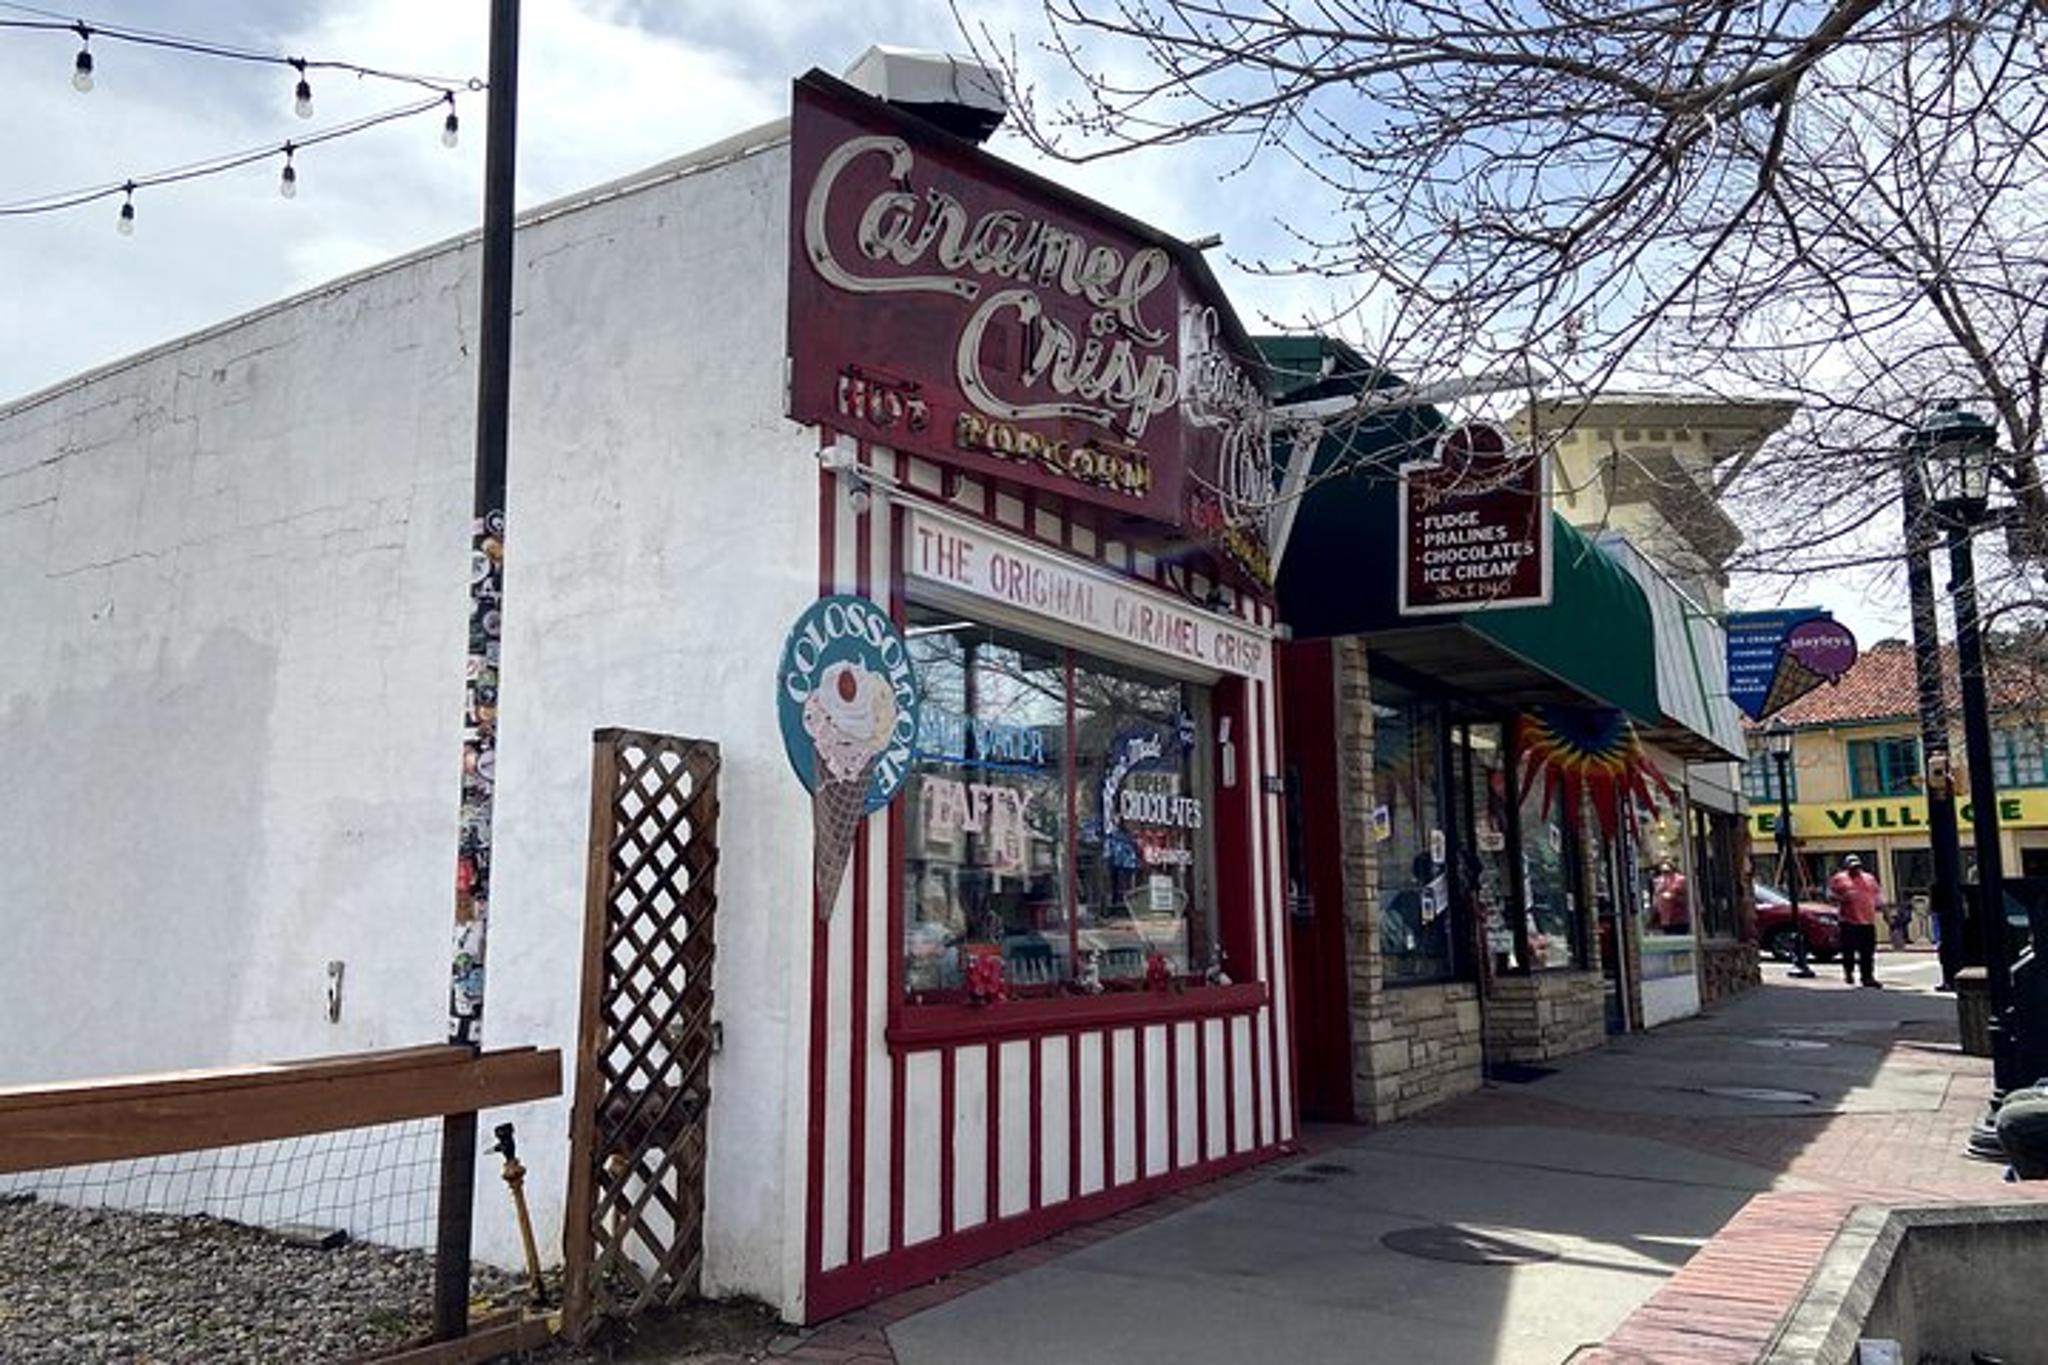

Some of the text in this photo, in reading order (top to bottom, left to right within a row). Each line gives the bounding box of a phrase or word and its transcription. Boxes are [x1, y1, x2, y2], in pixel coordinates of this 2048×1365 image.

[805, 135, 1170, 347] Caramel
[957, 289, 1179, 446] Crisp
[1424, 511, 1480, 530] FUDGE
[1424, 526, 1508, 547] PRALINES
[1423, 541, 1534, 564] CHOCOLATES
[1424, 561, 1517, 584] ICE CREAM
[918, 527, 1262, 674] THE ORIGINAL CARAMEL CRISP
[1120, 789, 1201, 829] CHOCOLATES
[1826, 799, 2023, 829] VILLGE
